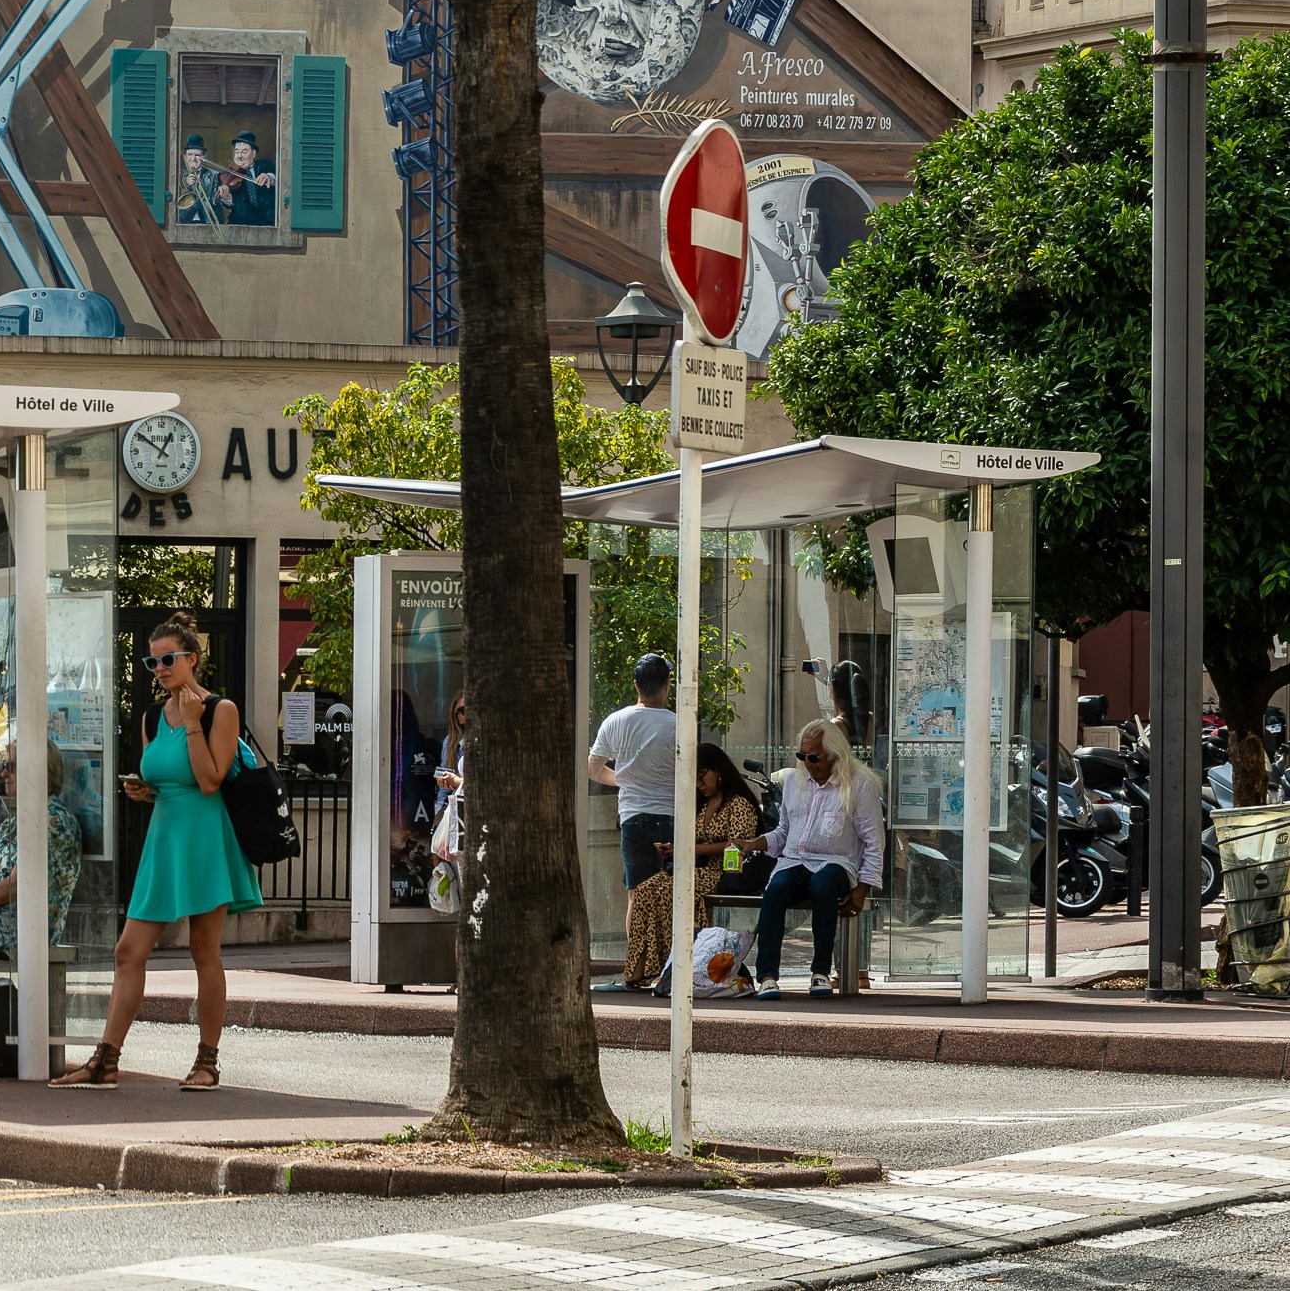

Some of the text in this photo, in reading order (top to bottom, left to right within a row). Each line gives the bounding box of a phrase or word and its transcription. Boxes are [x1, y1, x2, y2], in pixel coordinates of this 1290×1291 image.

[737, 51, 824, 84] A.Fresco
[740, 86, 855, 107] Peintures murales
[740, 113, 892, 130] 06 77 08 23 70 +41 22 779 27 09
[757, 159, 783, 174] 2001
[767, 172, 777, 180] DE
[685, 358, 702, 375] SAUF
[703, 360, 717, 378] BUS
[722, 363, 744, 382] POLICE
[16, 396, 55, 411] Hôtel
[60, 398, 77, 411] de
[83, 399, 115, 413] Ville
[697, 387, 733, 409] TAXIS ET
[681, 416, 744, 440] BENNE DE COLLECTE
[977, 454, 1064, 470] Hôtel de Ville
[121, 492, 193, 526] DES
[395, 577, 463, 595] “ENVOÛT
[400, 597, 446, 608] RÉINVENTE
[314, 722, 342, 733] PALM
[394, 888, 406, 896] TV
